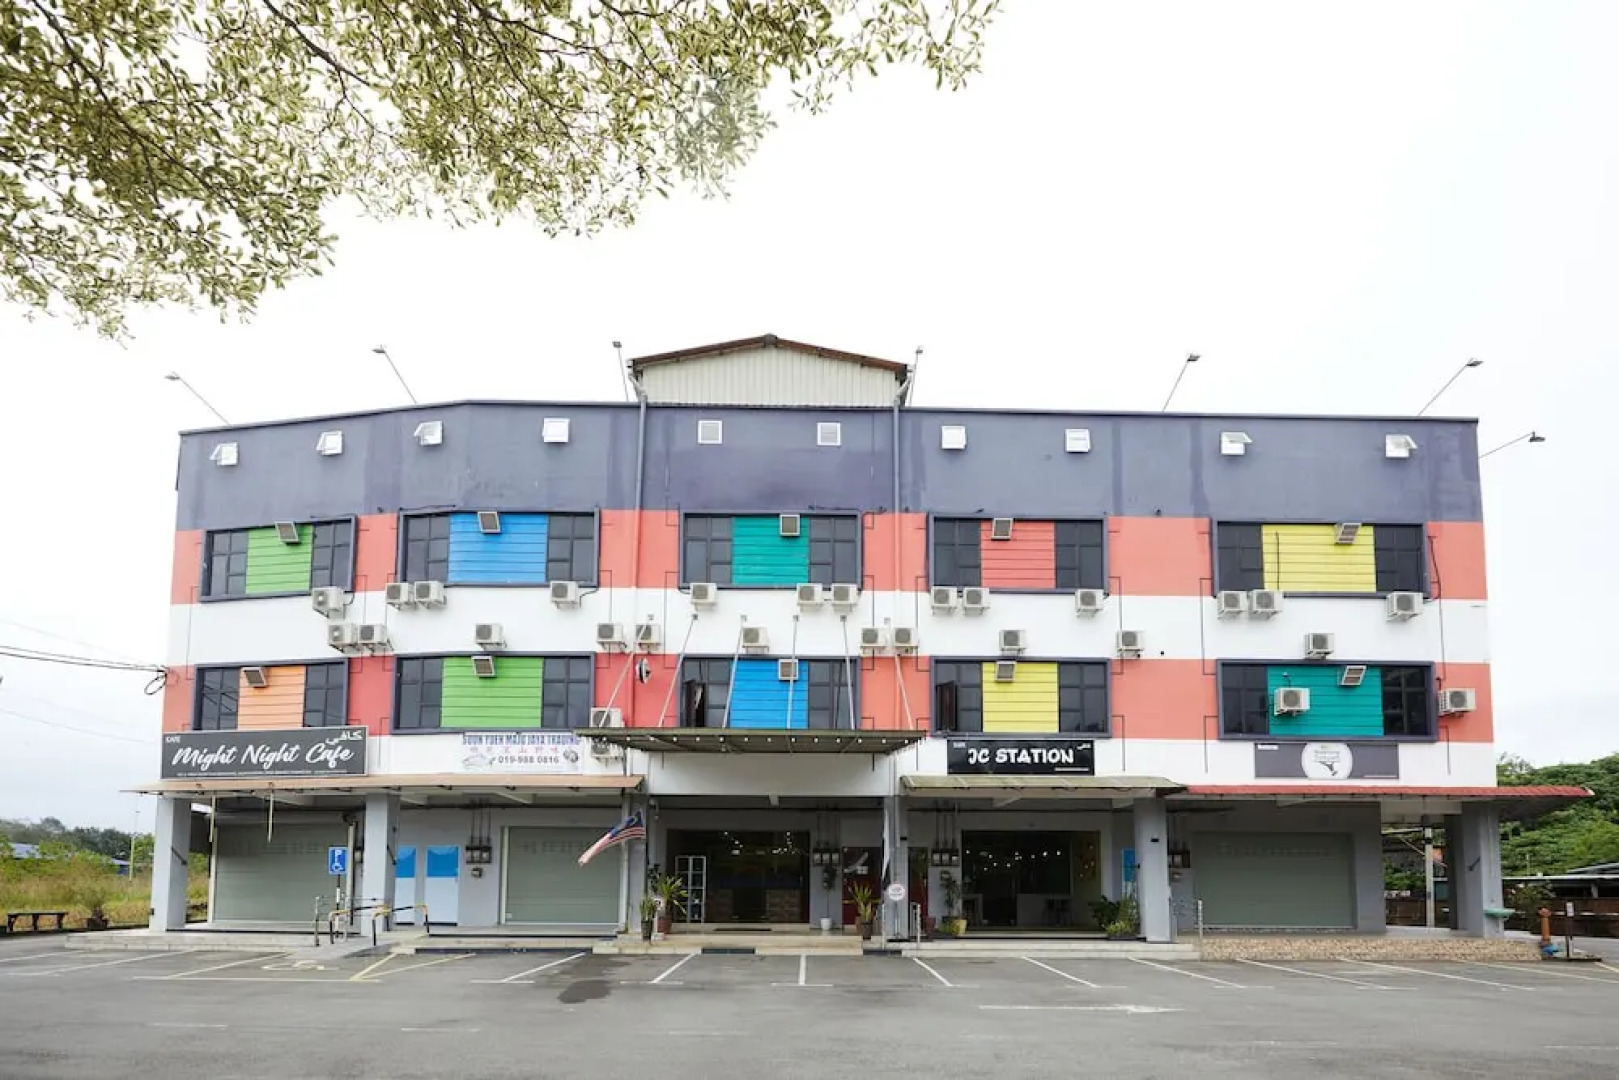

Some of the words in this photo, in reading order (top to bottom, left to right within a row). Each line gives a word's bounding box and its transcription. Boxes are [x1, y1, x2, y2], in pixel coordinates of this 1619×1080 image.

[171, 744, 237, 771] Might
[241, 742, 301, 769] Night
[305, 743, 354, 768] Cafe
[968, 748, 990, 764] JC
[995, 748, 1075, 764] STATION
